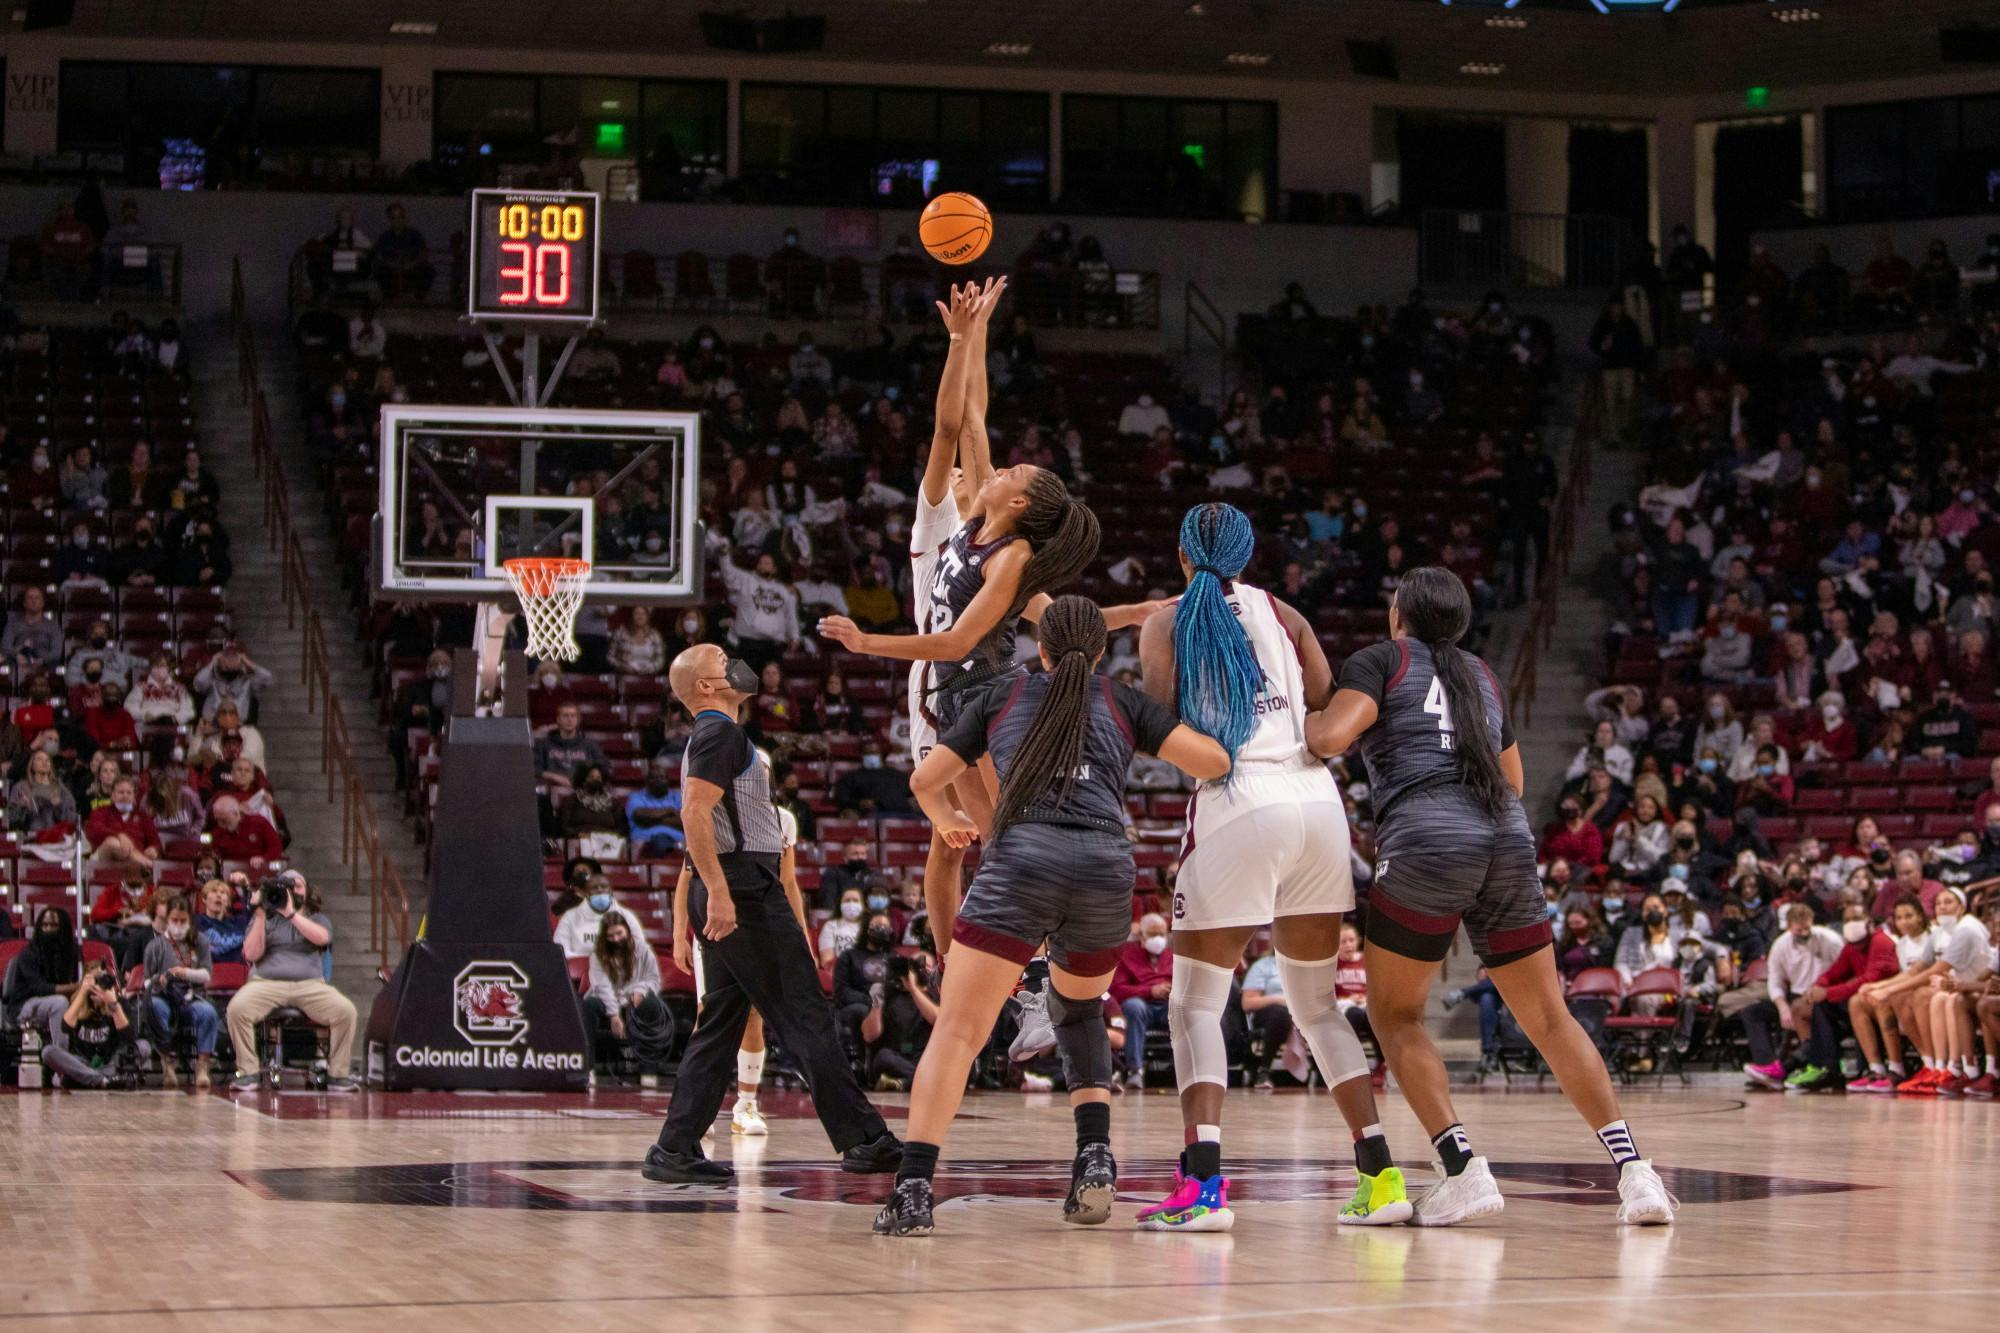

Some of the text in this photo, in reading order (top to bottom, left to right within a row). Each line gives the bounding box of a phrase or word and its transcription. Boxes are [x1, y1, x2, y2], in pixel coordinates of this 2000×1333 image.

[10, 74, 56, 97] VIP
[385, 85, 430, 106] VIP
[9, 97, 57, 112] CLUB
[384, 107, 431, 121] CLUB
[499, 205, 585, 241] 10:00
[499, 242, 570, 304] 30
[396, 1046, 583, 1070] Colonial Life Arena
